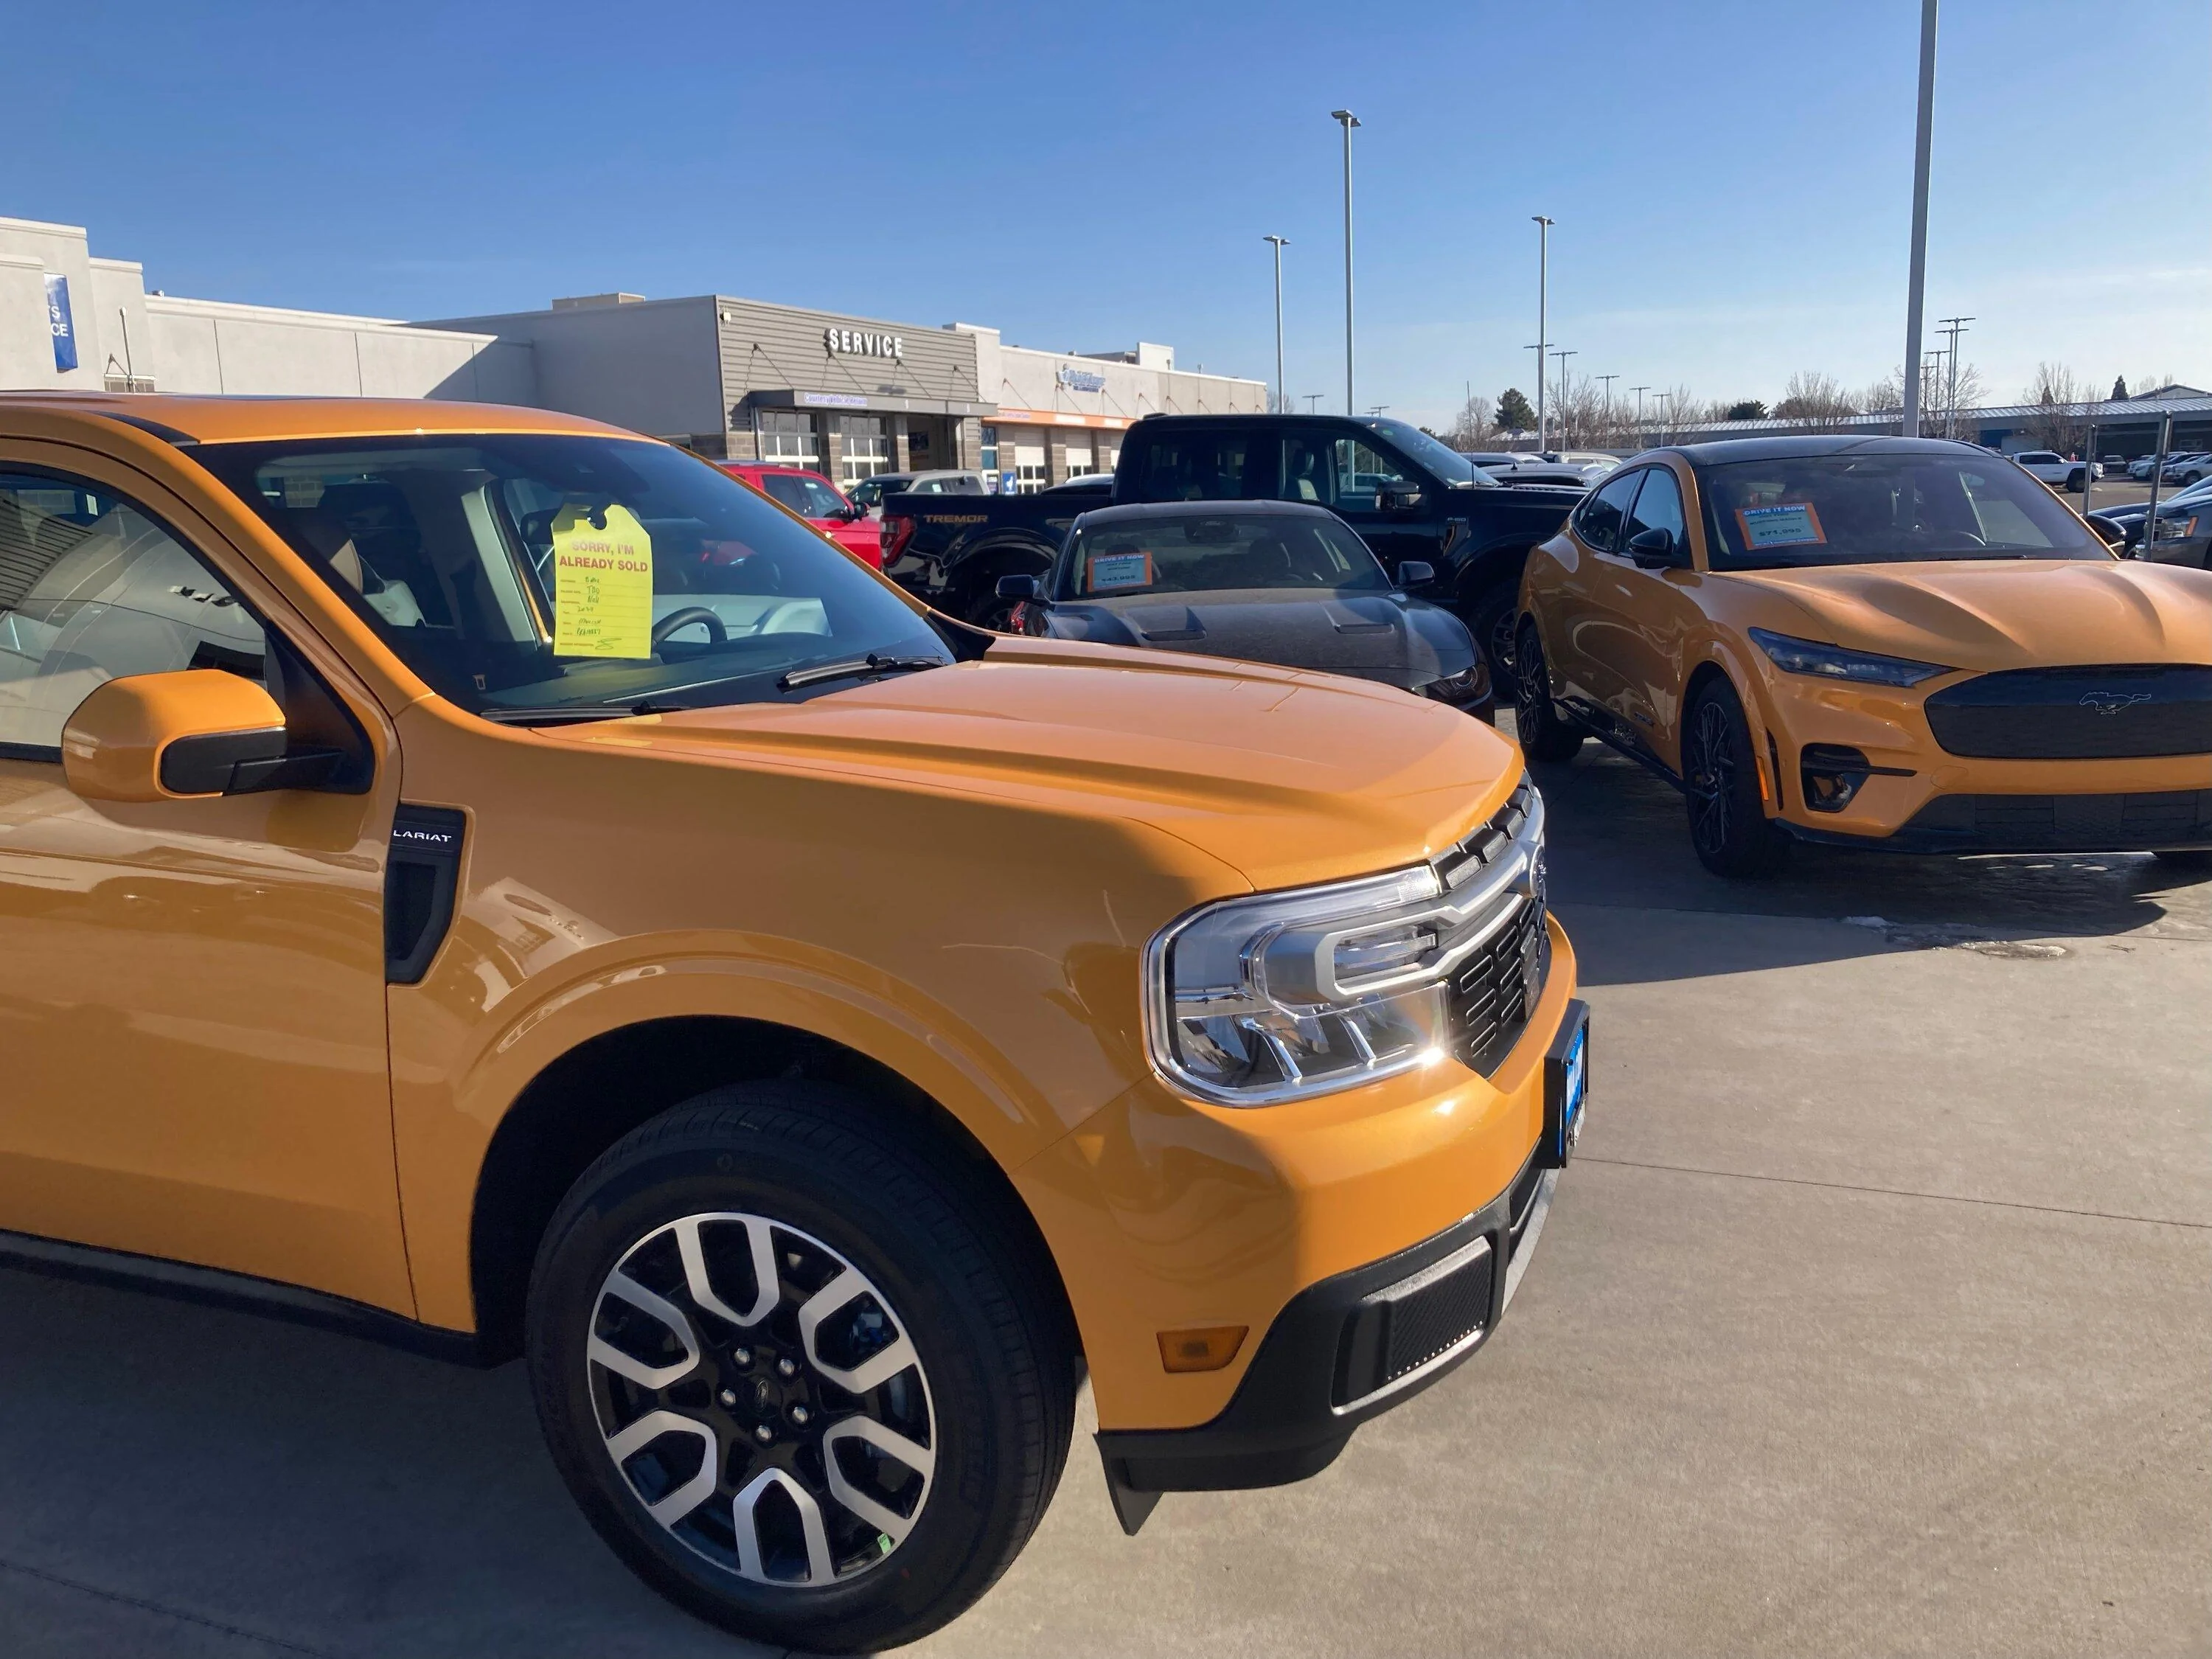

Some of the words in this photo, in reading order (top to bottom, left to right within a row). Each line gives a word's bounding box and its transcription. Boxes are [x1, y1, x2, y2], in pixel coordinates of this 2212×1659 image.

[829, 328, 902, 358] SERVICE
[923, 515, 989, 524] TREMOR
[572, 540, 614, 555] SORRY,
[617, 543, 634, 554] I'M
[560, 555, 614, 570] ALREADY
[618, 560, 648, 572] SOLD
[393, 830, 452, 843] LARIAT
